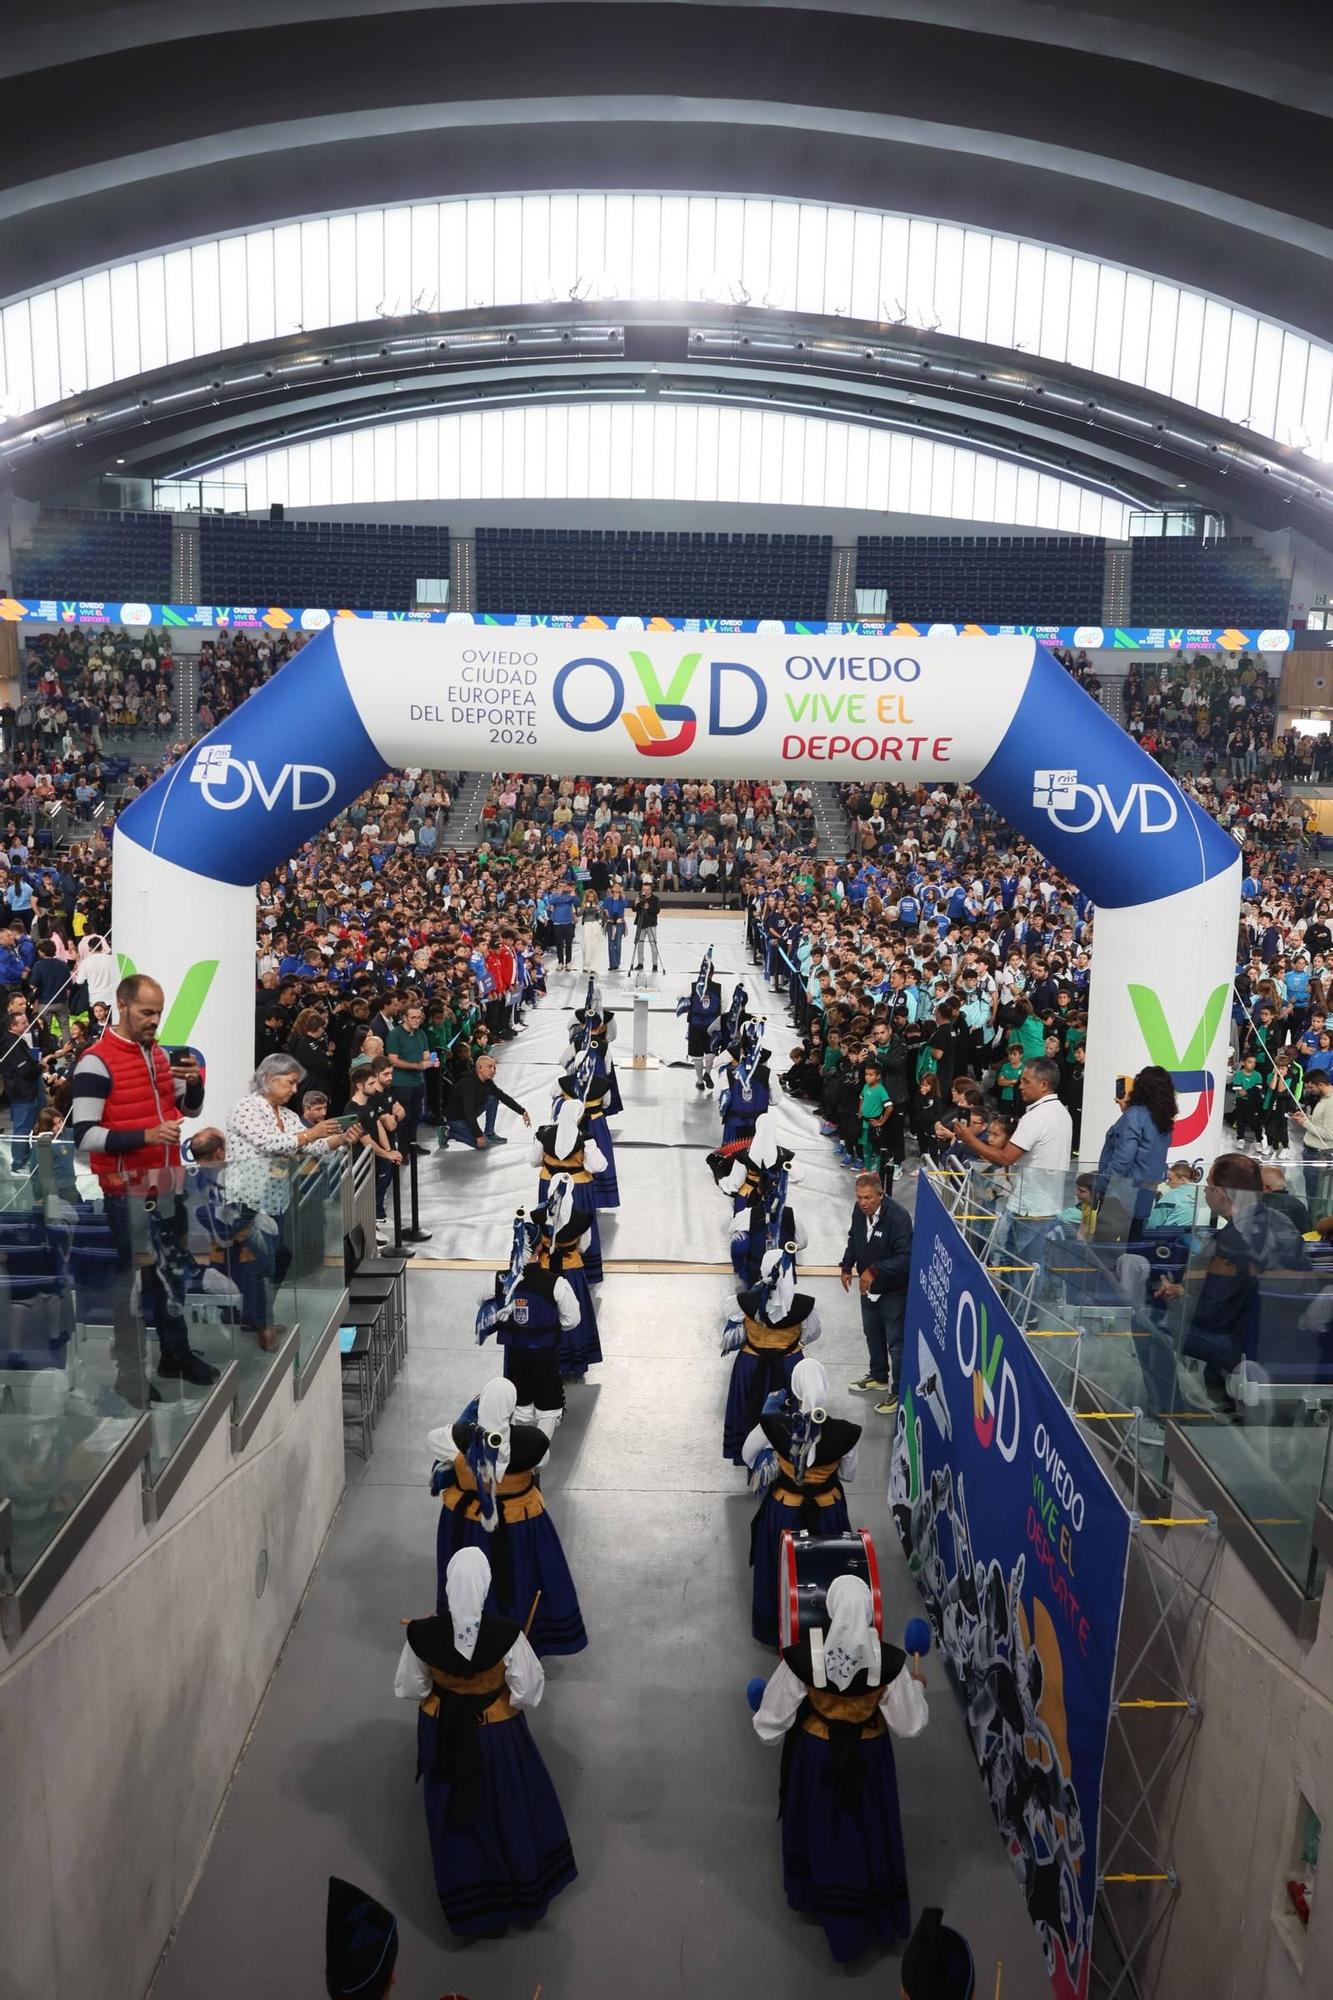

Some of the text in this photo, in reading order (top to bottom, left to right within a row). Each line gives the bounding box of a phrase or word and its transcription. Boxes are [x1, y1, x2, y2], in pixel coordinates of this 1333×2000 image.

[79, 602, 105, 610] OVIEDO
[462, 650, 538, 666] OVIEDO
[785, 656, 921, 682] OVIEDO
[461, 667, 538, 685] CIUDAD
[448, 686, 537, 706] EUROPEA
[784, 693, 914, 724] VIVE EL
[410, 705, 537, 727] DEL DEPORTE
[489, 729, 538, 745] 2026
[782, 735, 954, 762] DEPORTE
[201, 758, 337, 811] OVD
[1047, 783, 1178, 834] OVD
[1033, 1423, 1085, 1532] OVIEDO
[1031, 1462, 1075, 1578] VIVE EL
[1026, 1505, 1091, 1658] DEPORTE
